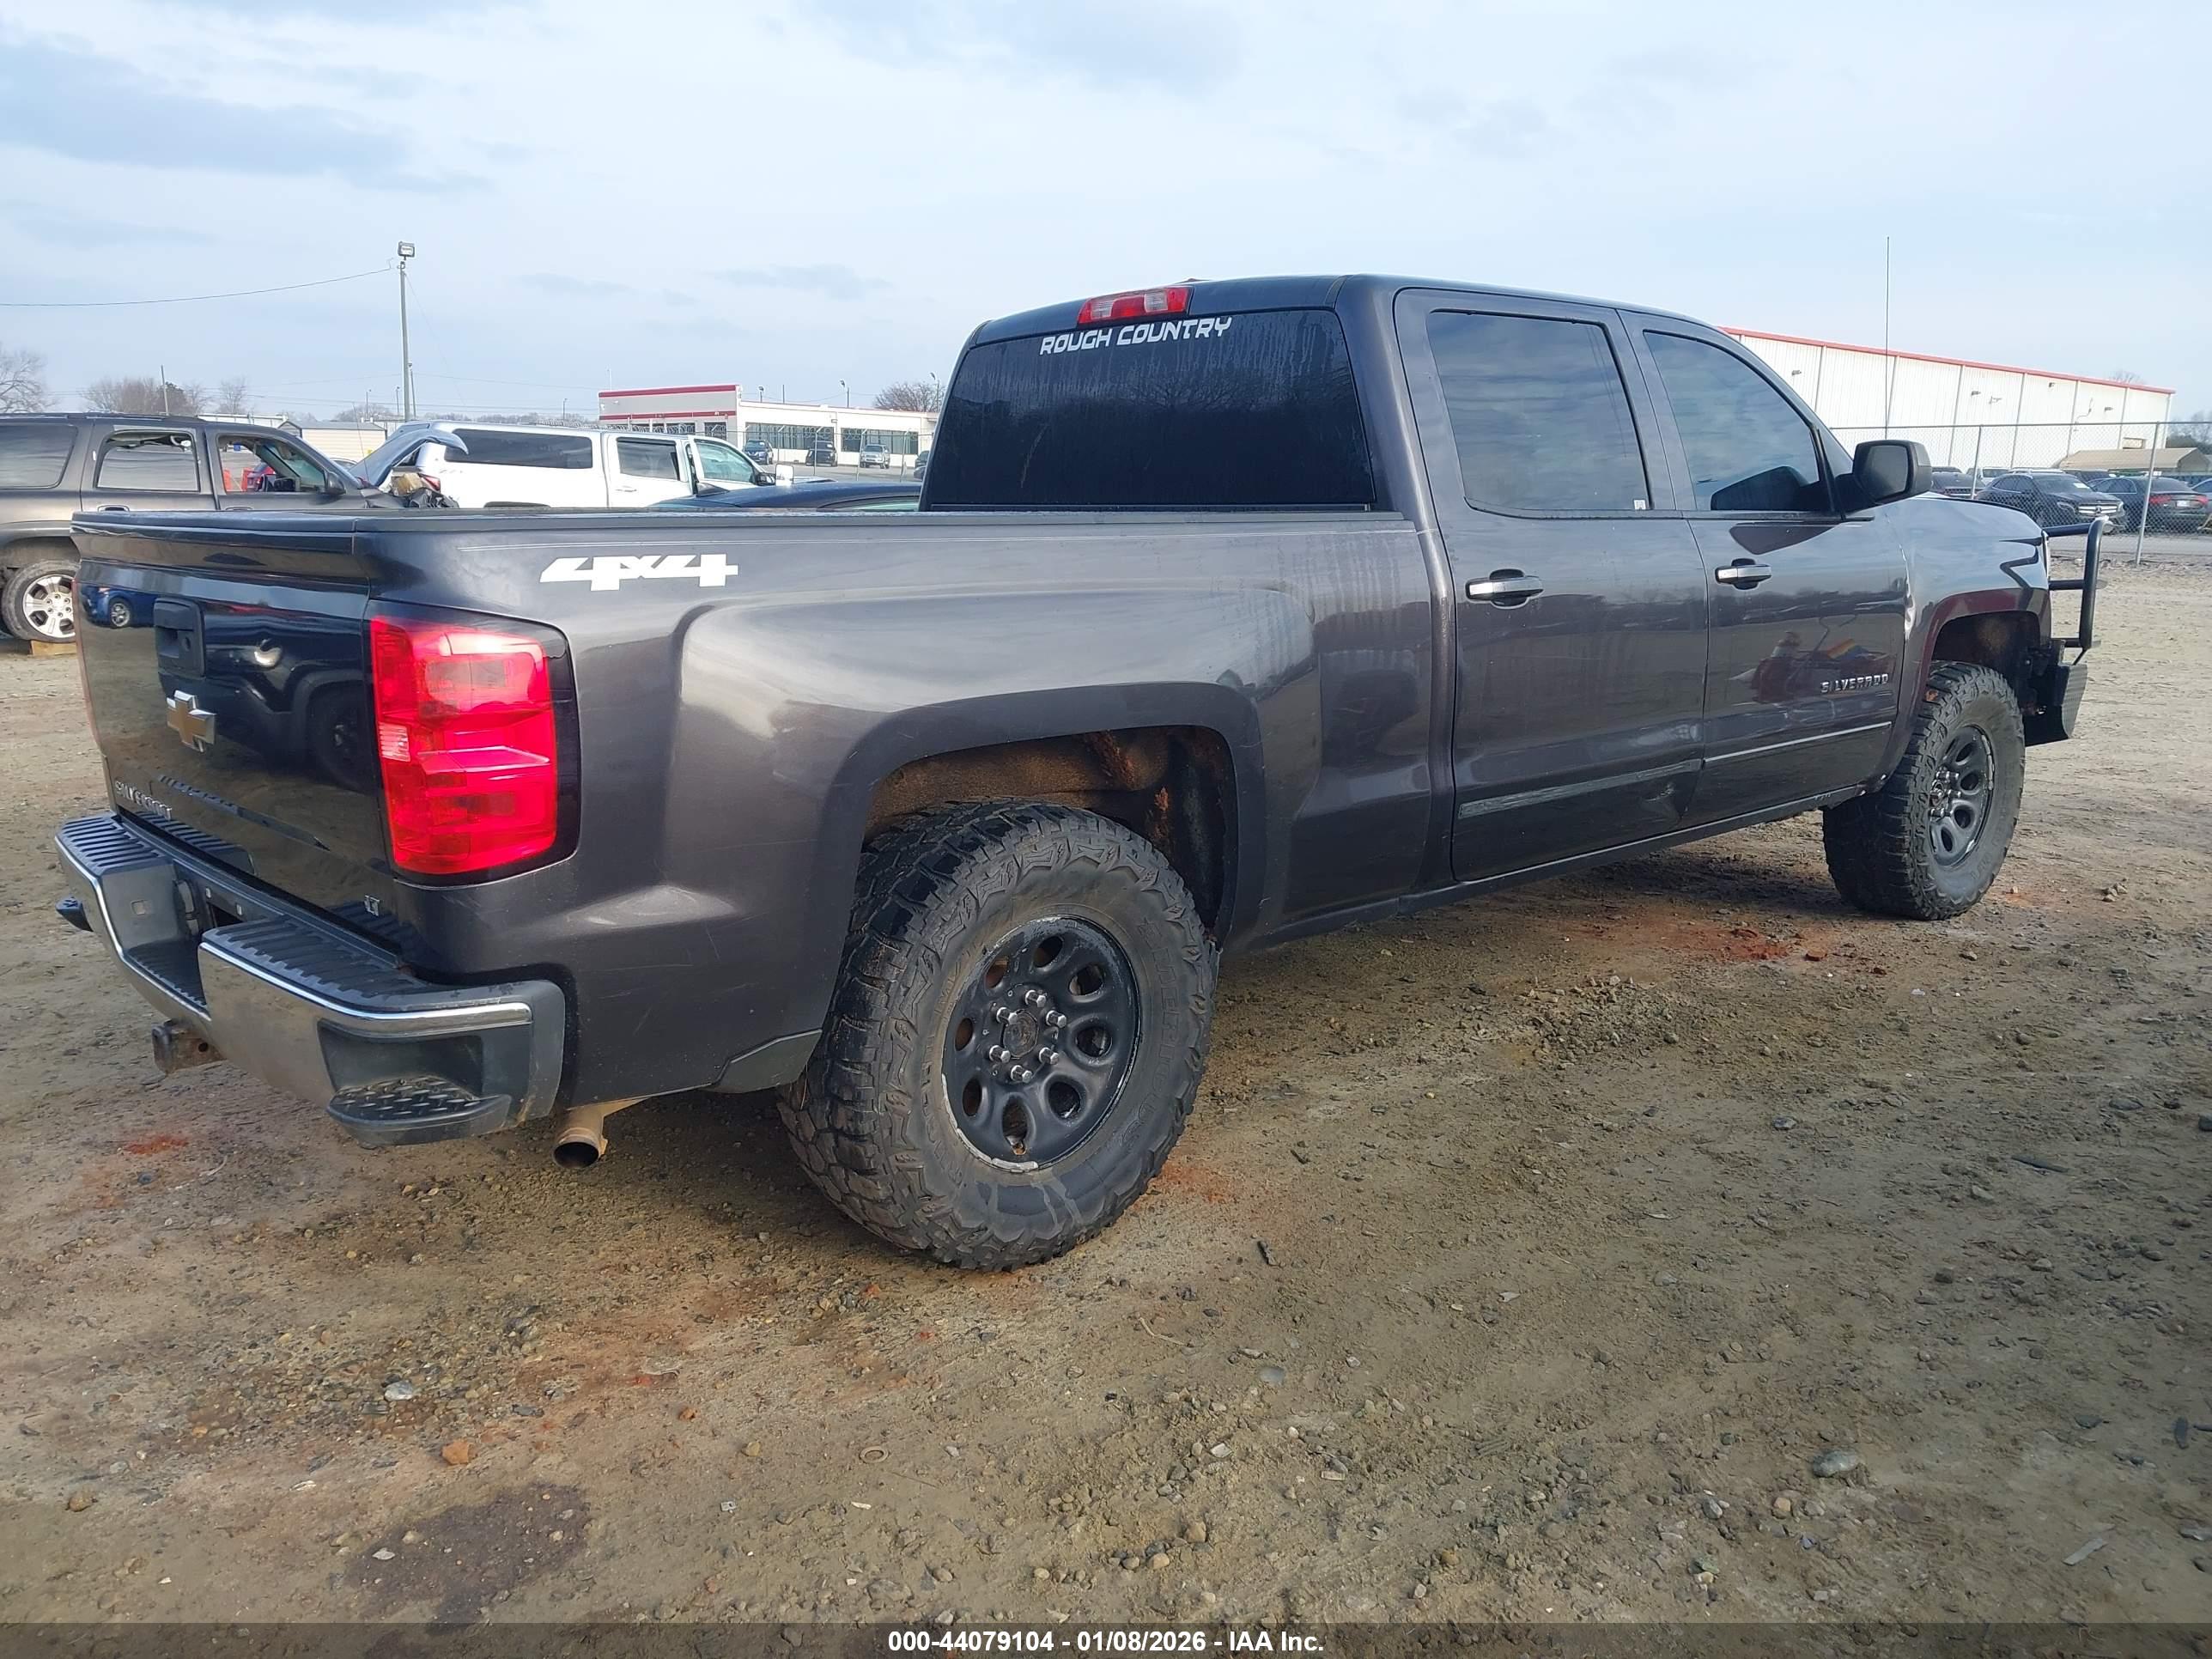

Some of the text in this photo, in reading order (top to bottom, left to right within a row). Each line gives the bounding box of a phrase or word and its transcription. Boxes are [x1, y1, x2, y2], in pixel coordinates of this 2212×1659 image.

[1040, 316, 1231, 356] ROUGH COUNTRY
[1820, 673, 1889, 693] SILVERADO
